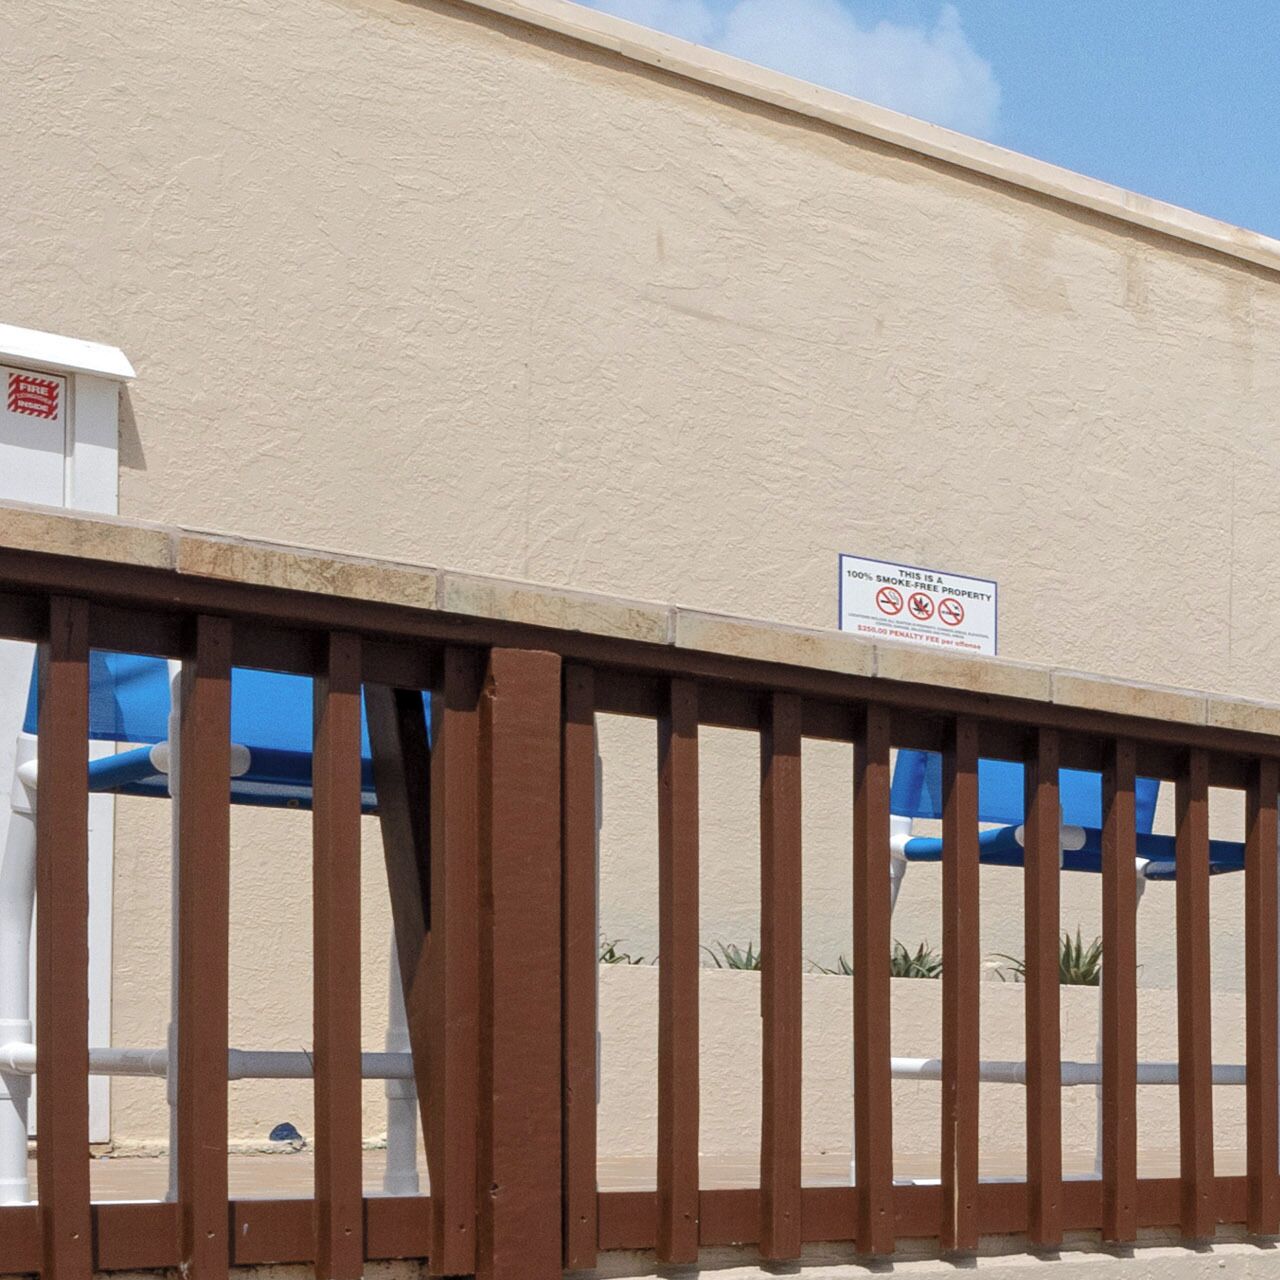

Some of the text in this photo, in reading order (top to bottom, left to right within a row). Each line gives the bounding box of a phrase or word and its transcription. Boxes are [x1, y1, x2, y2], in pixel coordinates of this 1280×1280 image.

[19, 383, 49, 396] FIRE
[899, 570, 921, 580] THIS
[924, 574, 934, 582] IS
[847, 570, 992, 601] 100% SMOKE-FREE PROPERTY
[889, 629, 924, 641] PENALTY
[926, 635, 940, 644] FEE
